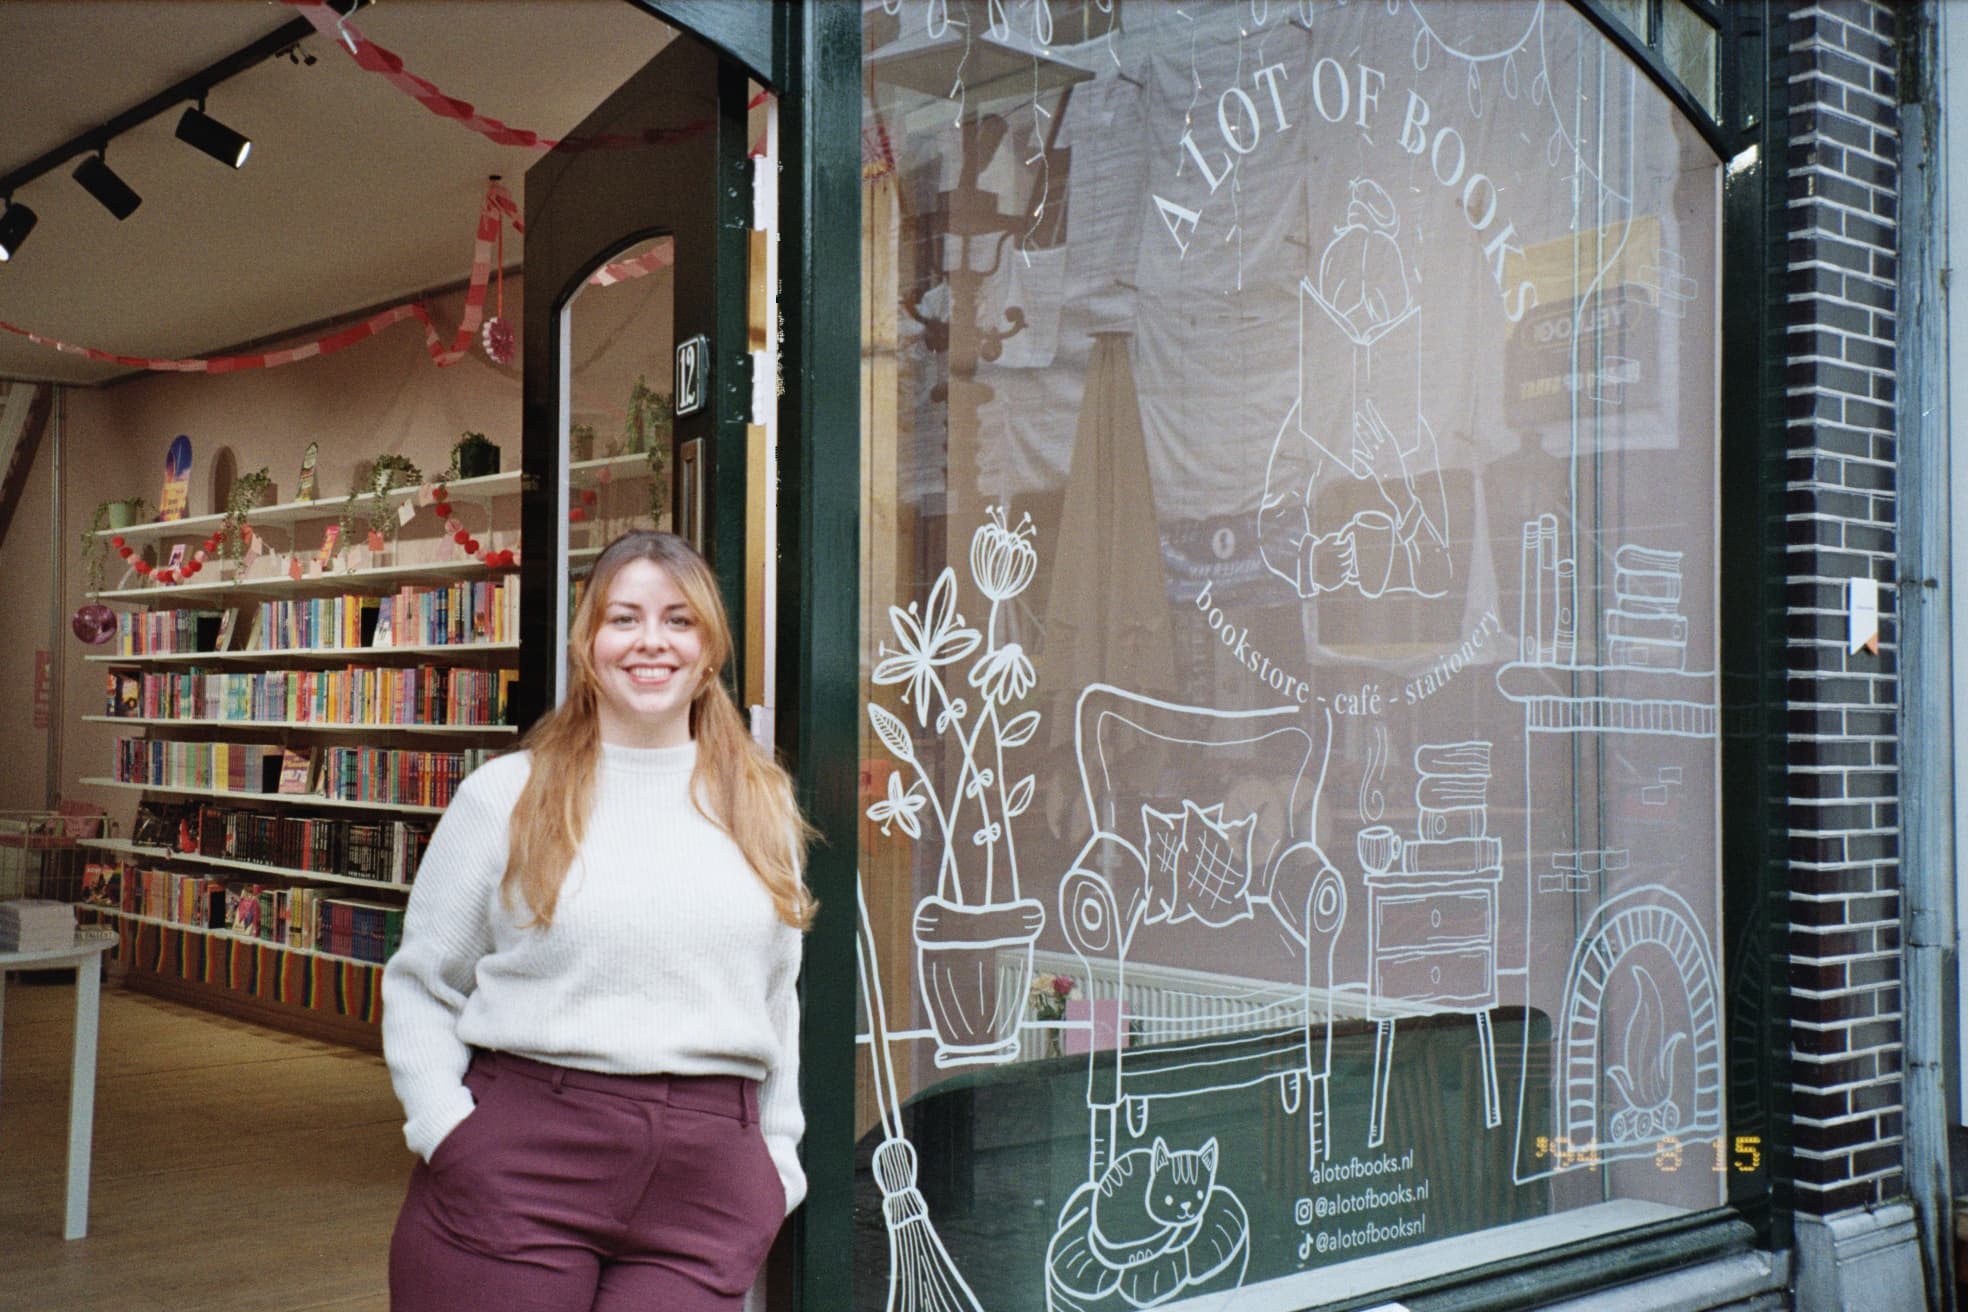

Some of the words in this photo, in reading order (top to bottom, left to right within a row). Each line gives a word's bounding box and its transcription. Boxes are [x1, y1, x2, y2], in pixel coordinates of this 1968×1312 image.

[1151, 193, 1202, 259] A
[1179, 62, 1293, 194] LOT
[1312, 57, 1386, 129] OF
[1399, 89, 1540, 322] BOOKS
[680, 345, 696, 409] 12
[1195, 580, 1310, 704] bookstore
[1334, 684, 1383, 715] café
[1405, 608, 1503, 706] stationery
[1312, 1149, 1414, 1185] alotofbooks.nl
[1314, 1179, 1429, 1218] @alotofbooks.nl
[1315, 1213, 1426, 1253] @alotofbooksnl
